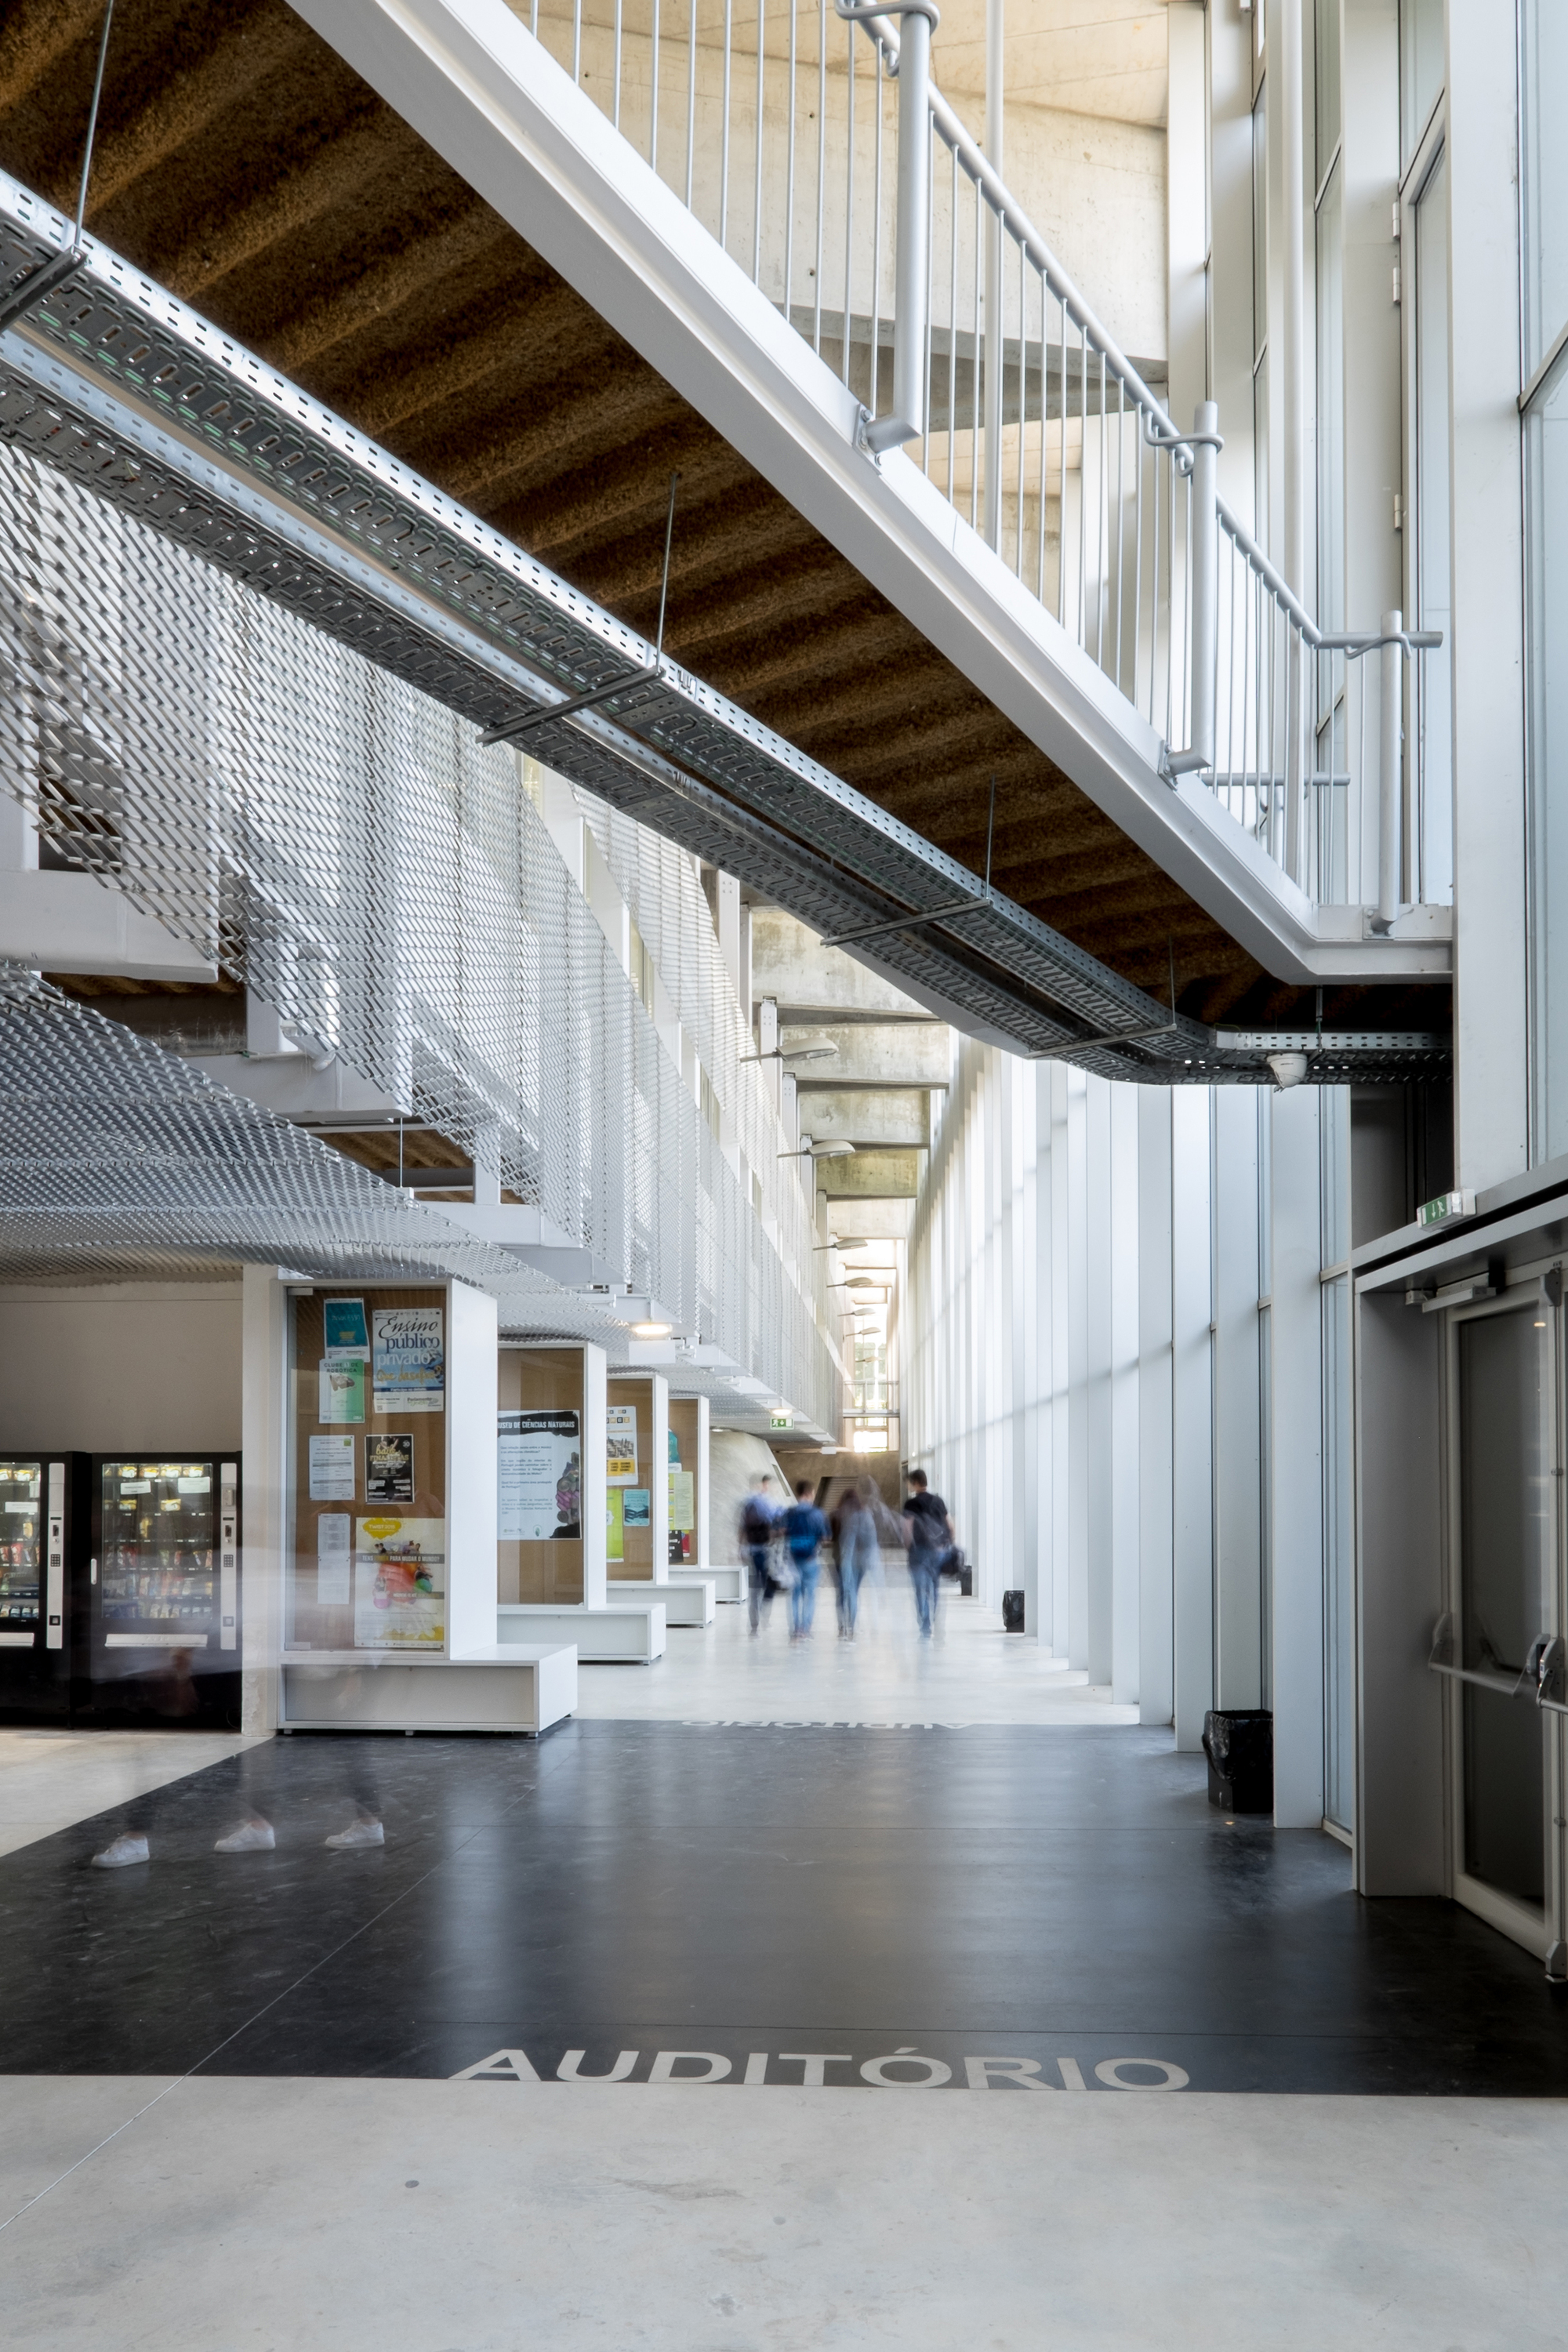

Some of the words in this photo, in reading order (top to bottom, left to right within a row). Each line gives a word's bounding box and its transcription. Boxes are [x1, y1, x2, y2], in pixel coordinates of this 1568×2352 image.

[375, 1316, 438, 1339] Ensino
[386, 1333, 440, 1354] público
[377, 1350, 430, 1369] privado
[522, 1418, 546, 1428] CIÊNCIAS
[448, 2047, 1191, 2092] AUDITÓRIO
